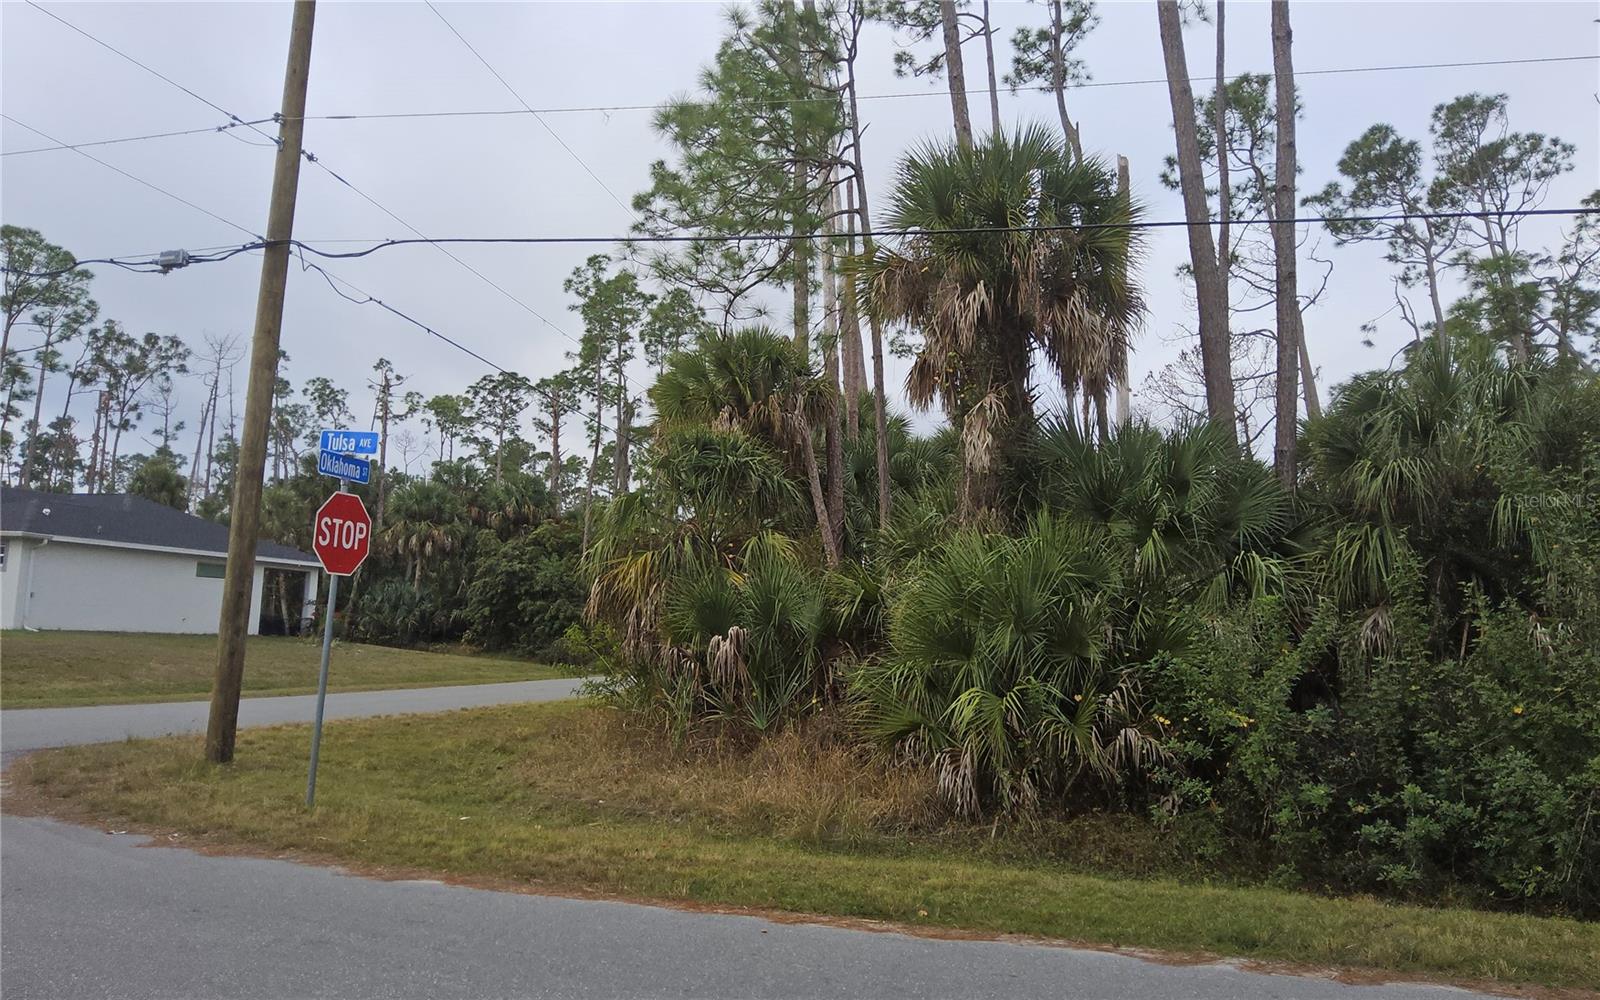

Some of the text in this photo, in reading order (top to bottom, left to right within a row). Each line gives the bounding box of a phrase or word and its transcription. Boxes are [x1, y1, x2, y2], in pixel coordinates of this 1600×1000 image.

[327, 433, 372, 451] Tulsa AVE
[320, 453, 368, 479] Oklahoma ST
[318, 517, 367, 550] STOP
